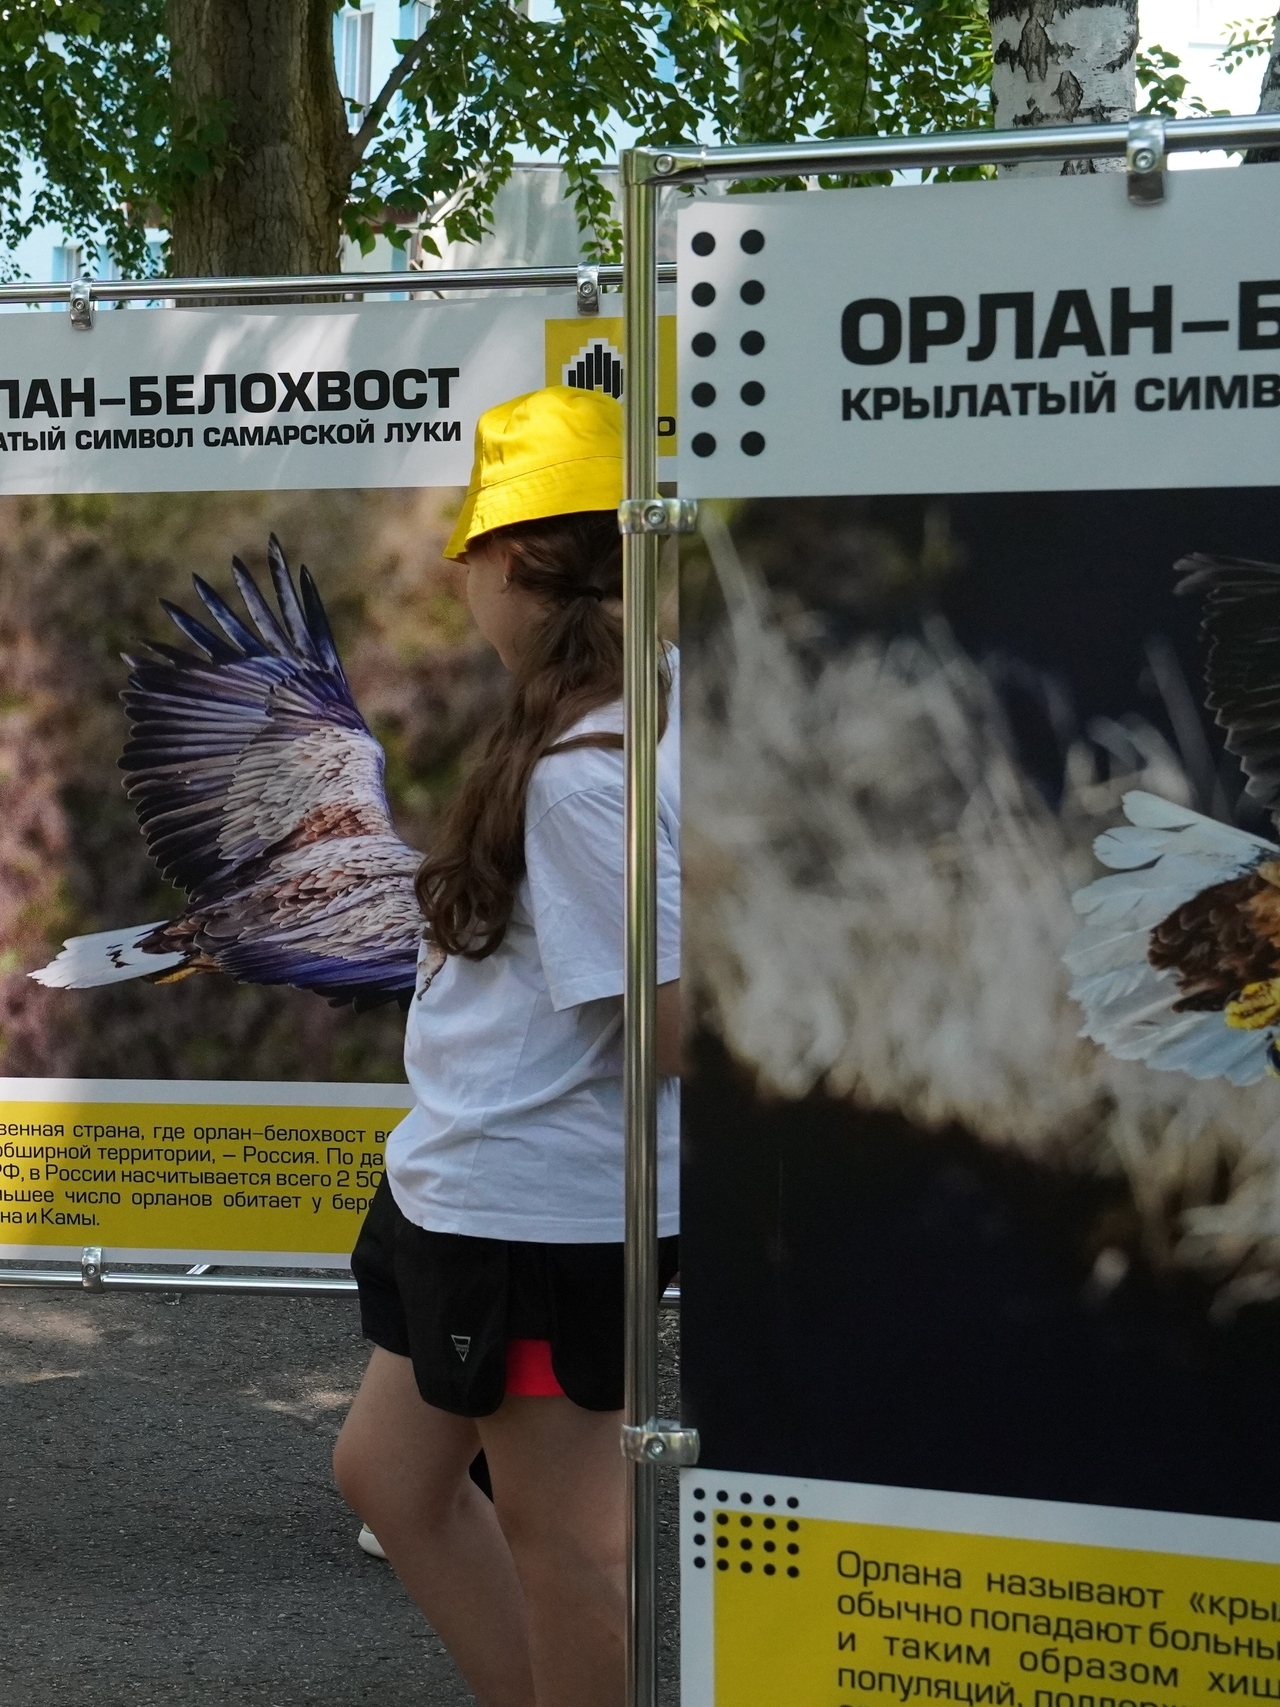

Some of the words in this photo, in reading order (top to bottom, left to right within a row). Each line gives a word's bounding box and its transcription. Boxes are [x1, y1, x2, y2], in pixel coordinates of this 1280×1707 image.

[841, 371, 1116, 422] КРЫЛАТЫЙ
[1135, 373, 1280, 413] СИМВ
[75, 428, 194, 450] СИМВОЛ
[203, 418, 375, 447] САМАРСКОЙ
[384, 421, 462, 444] ЛУКИ
[73, 1124, 145, 1142] страна,
[153, 1126, 185, 1142] где
[97, 1147, 216, 1165] территории,
[243, 1146, 320, 1164] Россия.
[326, 1147, 354, 1165] По
[30, 1168, 40, 1180] в
[45, 1164, 116, 1182] России
[121, 1170, 271, 1186] насчитывается
[276, 1173, 332, 1187] всего
[337, 1170, 350, 1187] 2
[65, 1190, 121, 1205] число
[131, 1192, 212, 1209] орланов
[223, 1191, 302, 1209] обитает
[311, 1196, 322, 1214] у
[26, 1211, 37, 1224] и
[41, 1208, 100, 1226] Камы.
[837, 1550, 962, 1588] Орлана
[987, 1573, 1165, 1610] называют
[837, 1591, 963, 1626] обычно
[971, 1608, 1143, 1645] попадают
[838, 1631, 856, 1652] и
[884, 1636, 990, 1667] таким
[1020, 1647, 1179, 1688] образом
